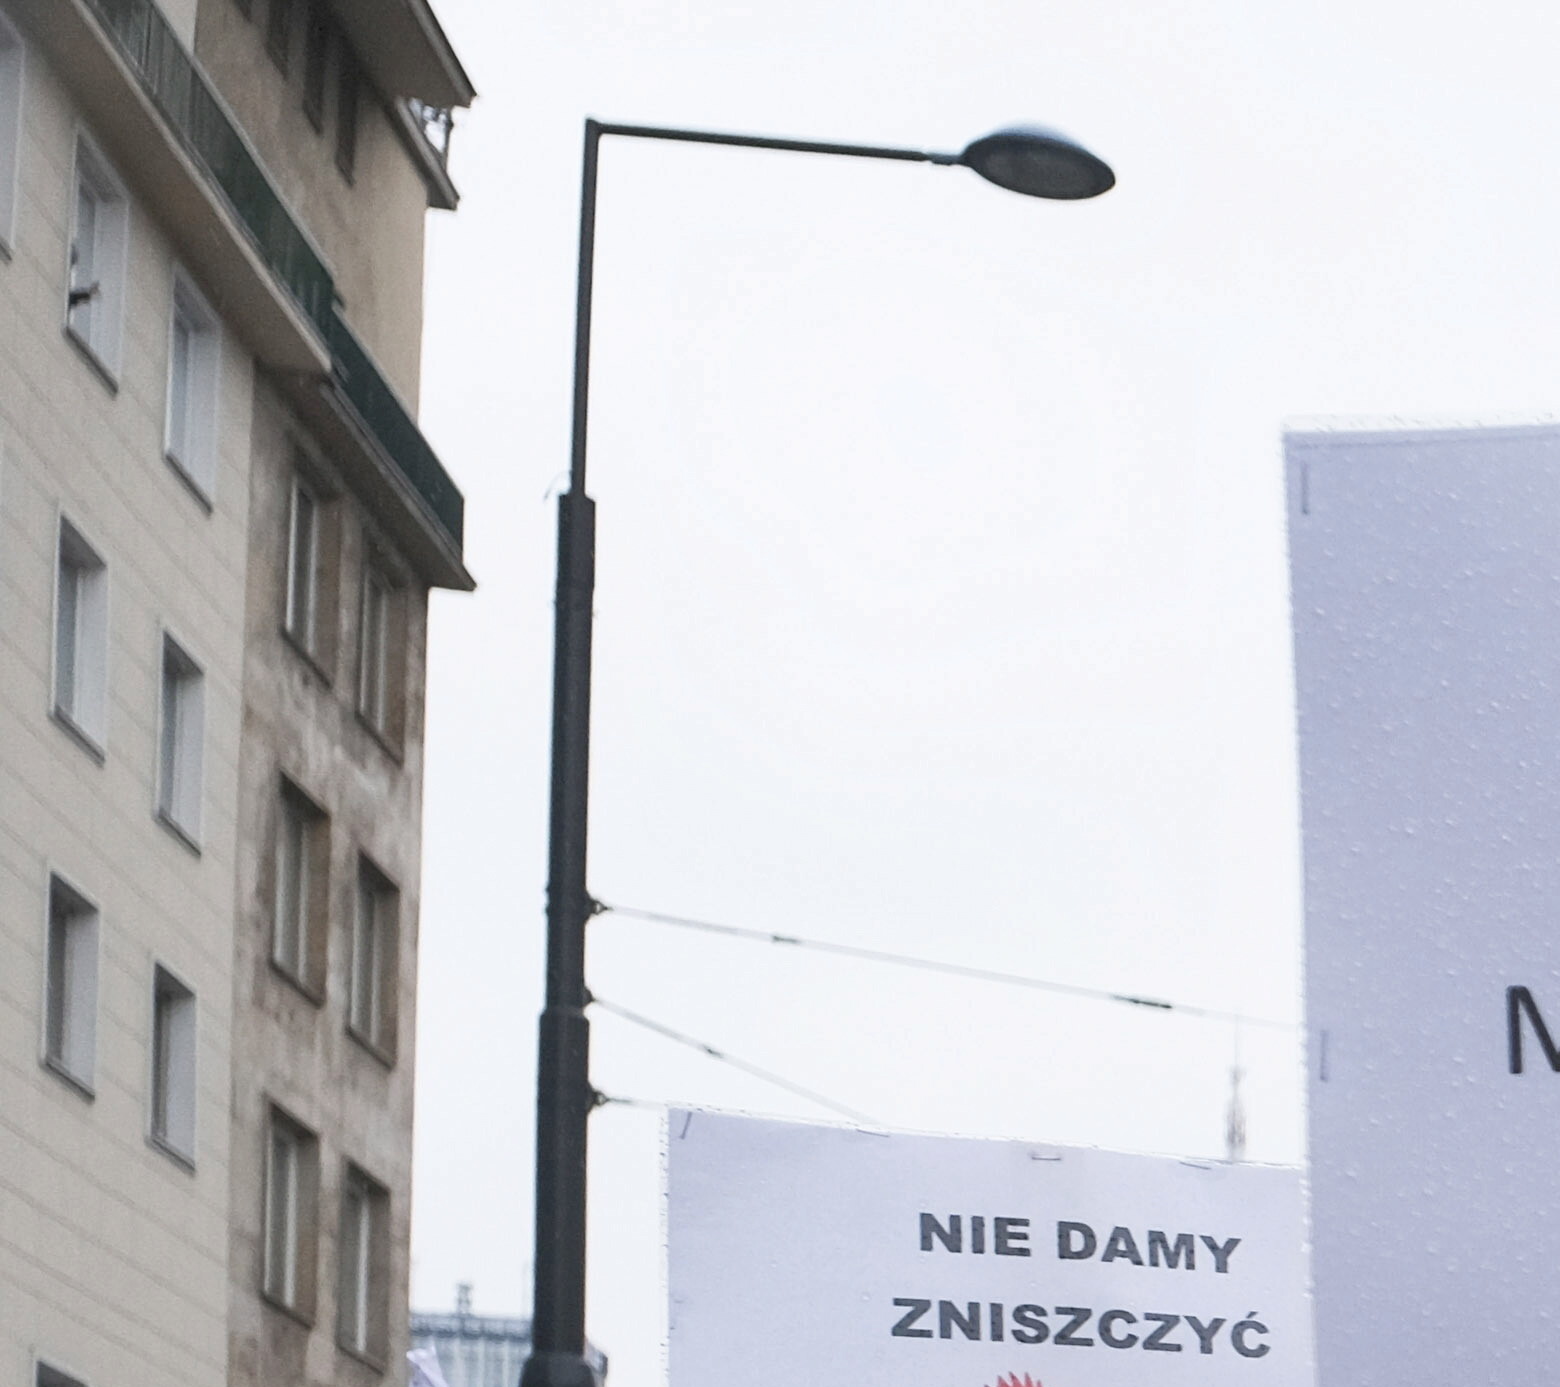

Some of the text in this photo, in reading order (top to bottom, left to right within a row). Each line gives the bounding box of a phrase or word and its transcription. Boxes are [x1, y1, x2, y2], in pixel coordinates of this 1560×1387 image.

[919, 1212, 1241, 1273] NIE DAMY
[891, 1298, 1271, 1358] ZNISZCZYĆ
